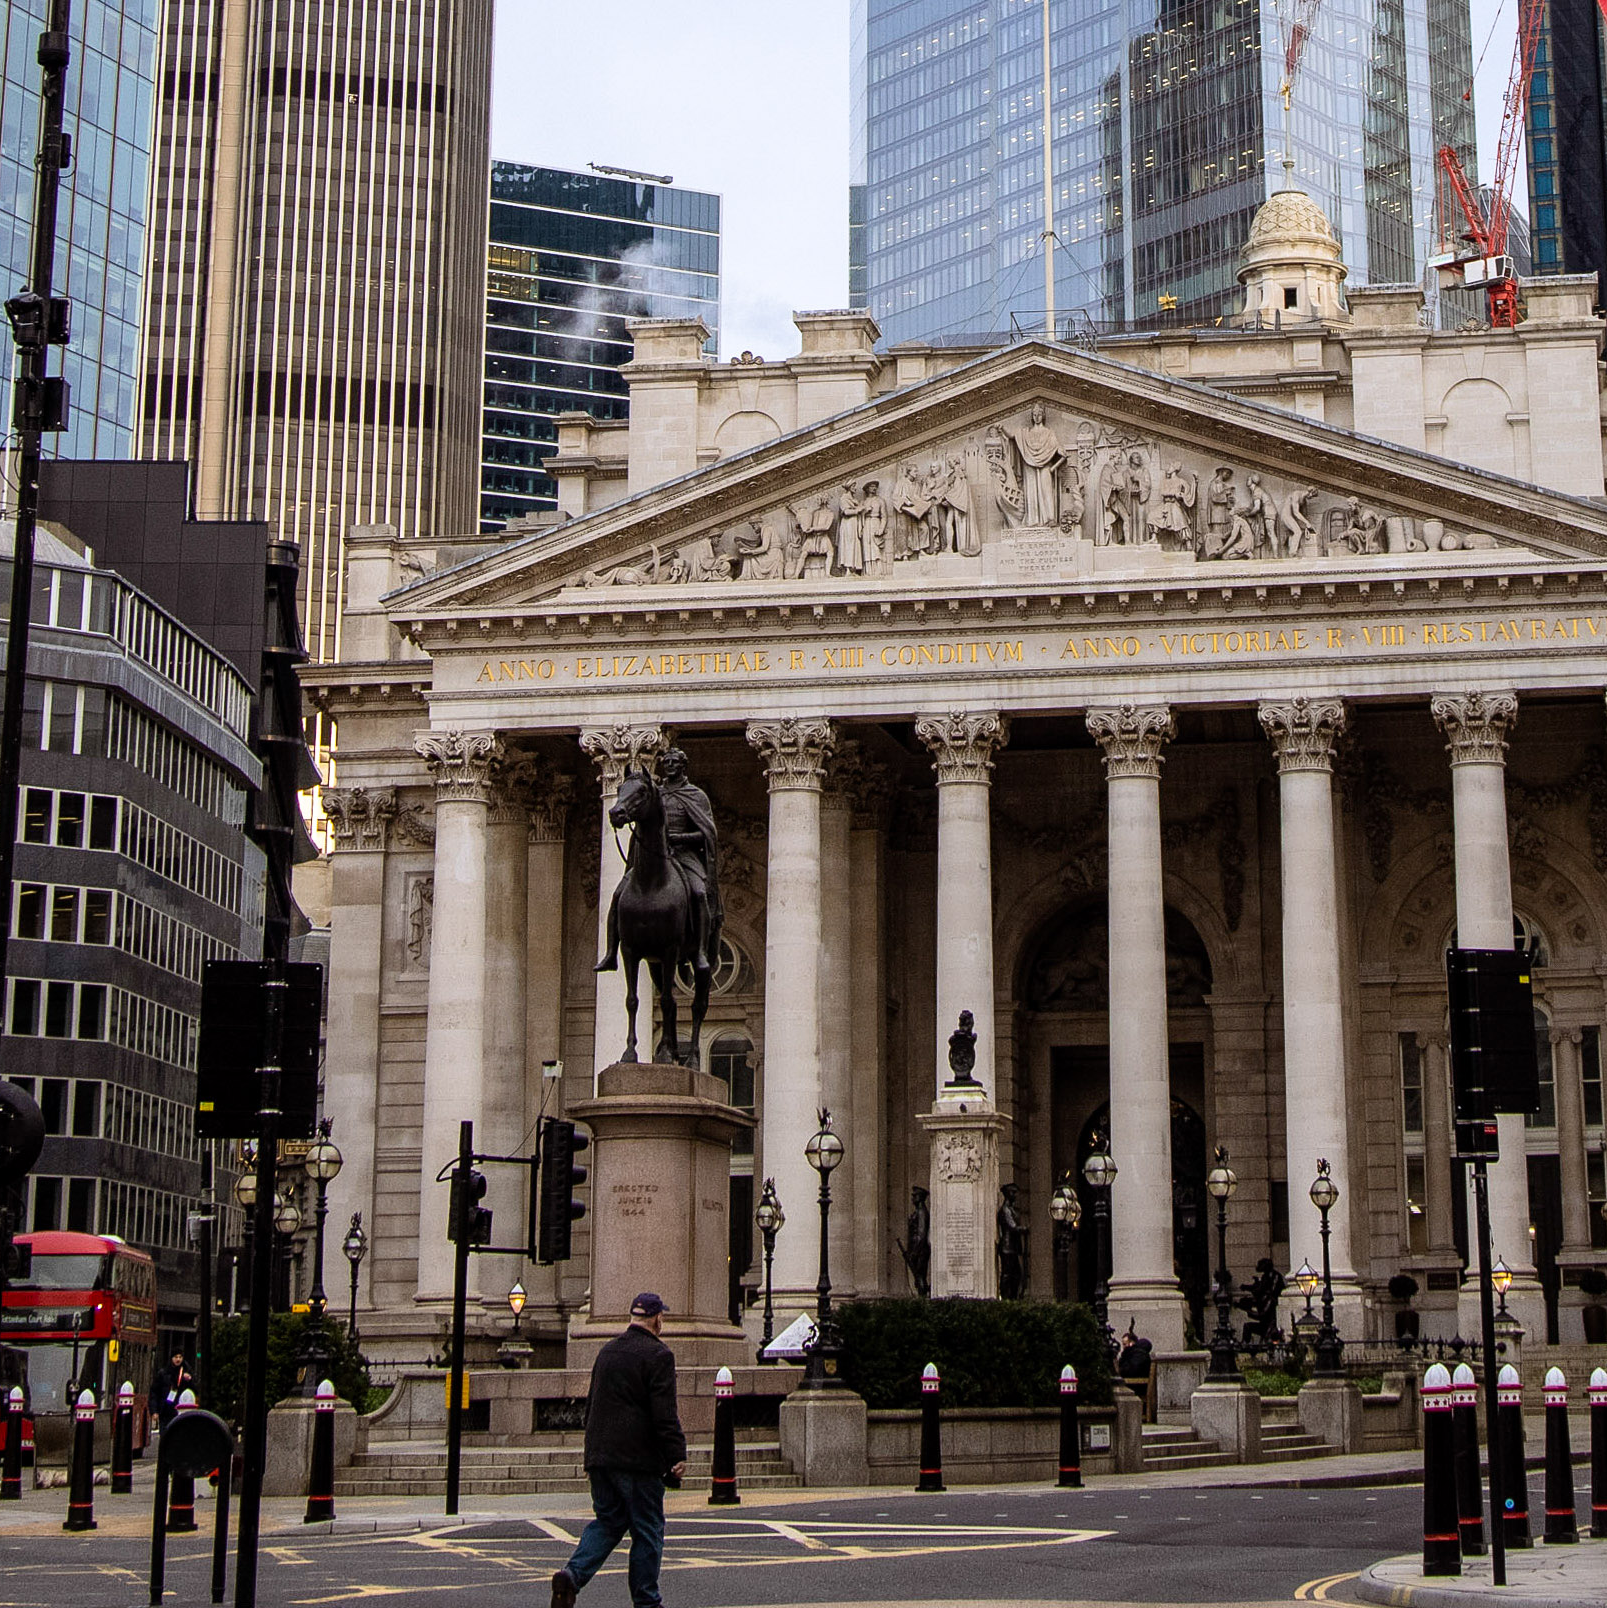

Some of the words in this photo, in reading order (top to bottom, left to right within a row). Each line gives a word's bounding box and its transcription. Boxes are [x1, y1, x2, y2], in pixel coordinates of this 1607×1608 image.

[476, 659, 556, 682] ANNO
[575, 651, 771, 678] ELIZABETHAE
[789, 649, 805, 670] R
[822, 647, 864, 668] XIII
[880, 641, 1024, 666] CONDITVM
[1060, 635, 1142, 659] ANNO
[1158, 628, 1309, 655] VICTORIAE
[1326, 627, 1344, 649] R
[1361, 624, 1406, 646] VIII
[612, 1184, 659, 1193] ERECTED
[618, 1196, 642, 1204] JUNE
